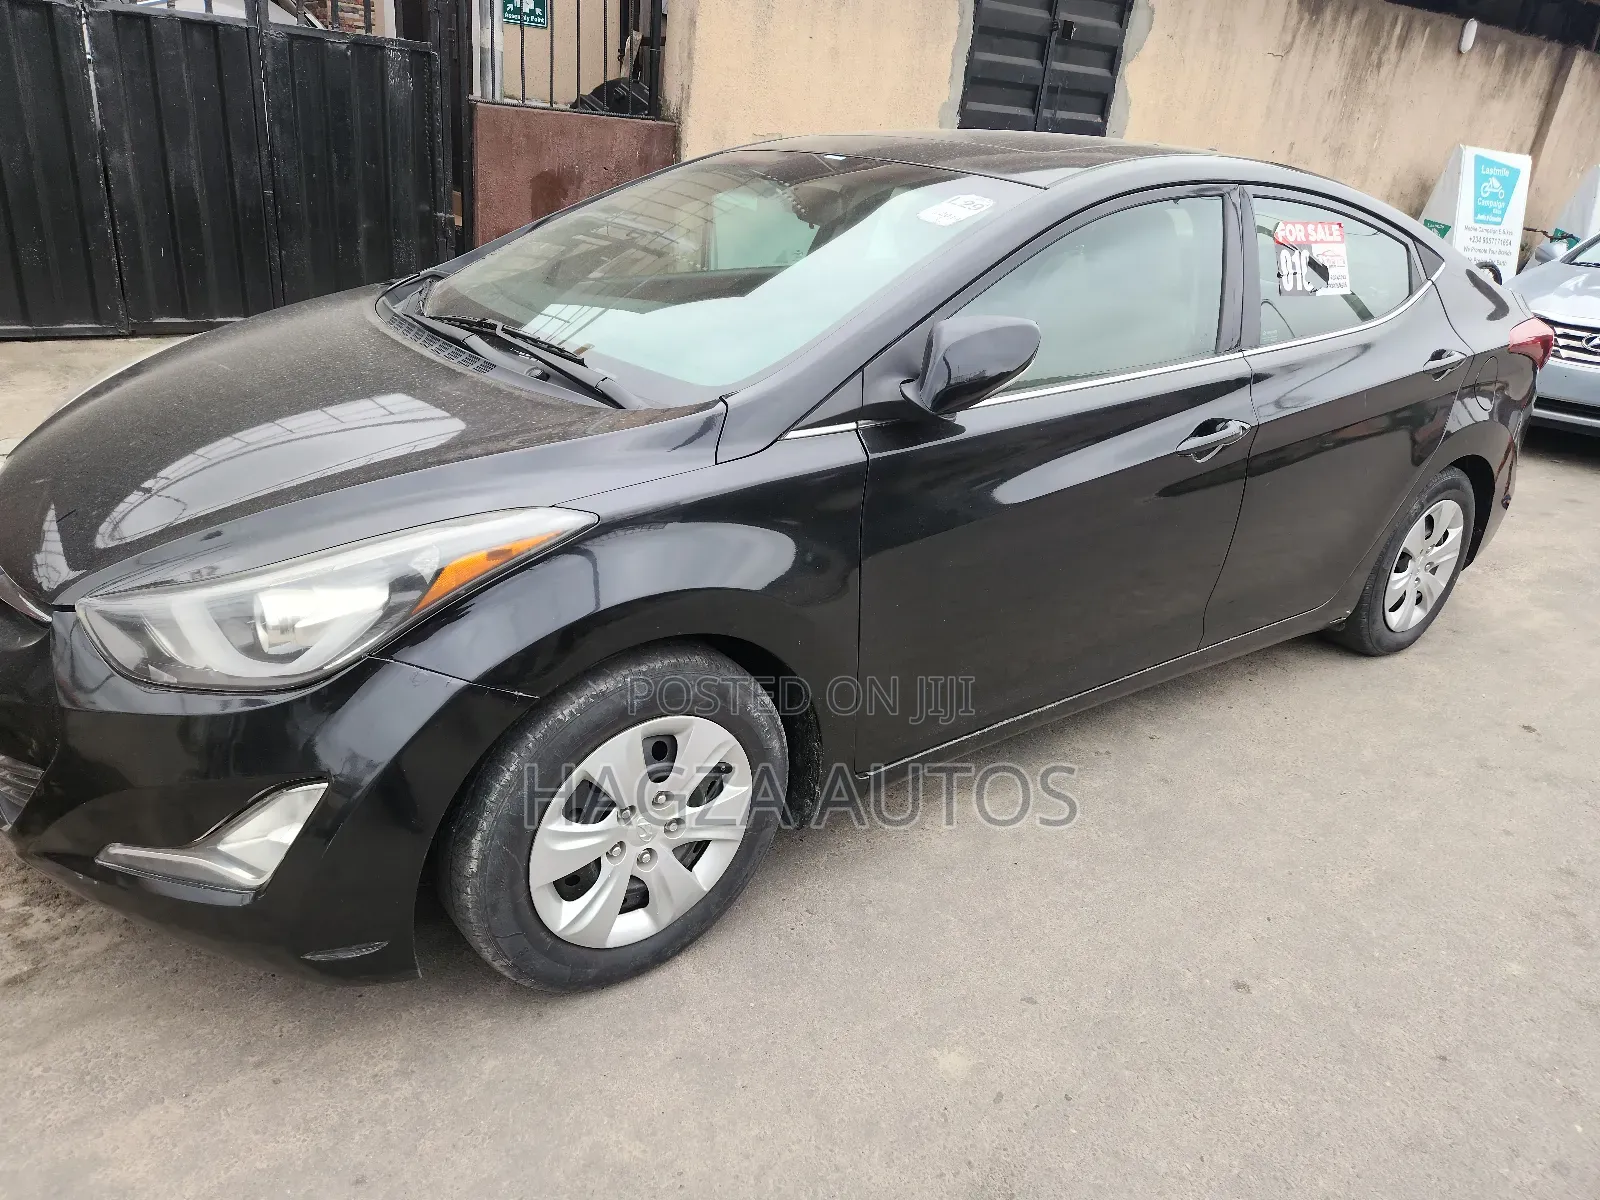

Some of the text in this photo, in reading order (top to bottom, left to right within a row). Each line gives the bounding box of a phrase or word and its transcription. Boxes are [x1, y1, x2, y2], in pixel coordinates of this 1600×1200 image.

[504, 12, 530, 22] Assely
[1481, 164, 1509, 177] Lastmile
[1278, 224, 1342, 241] FOR SALE
